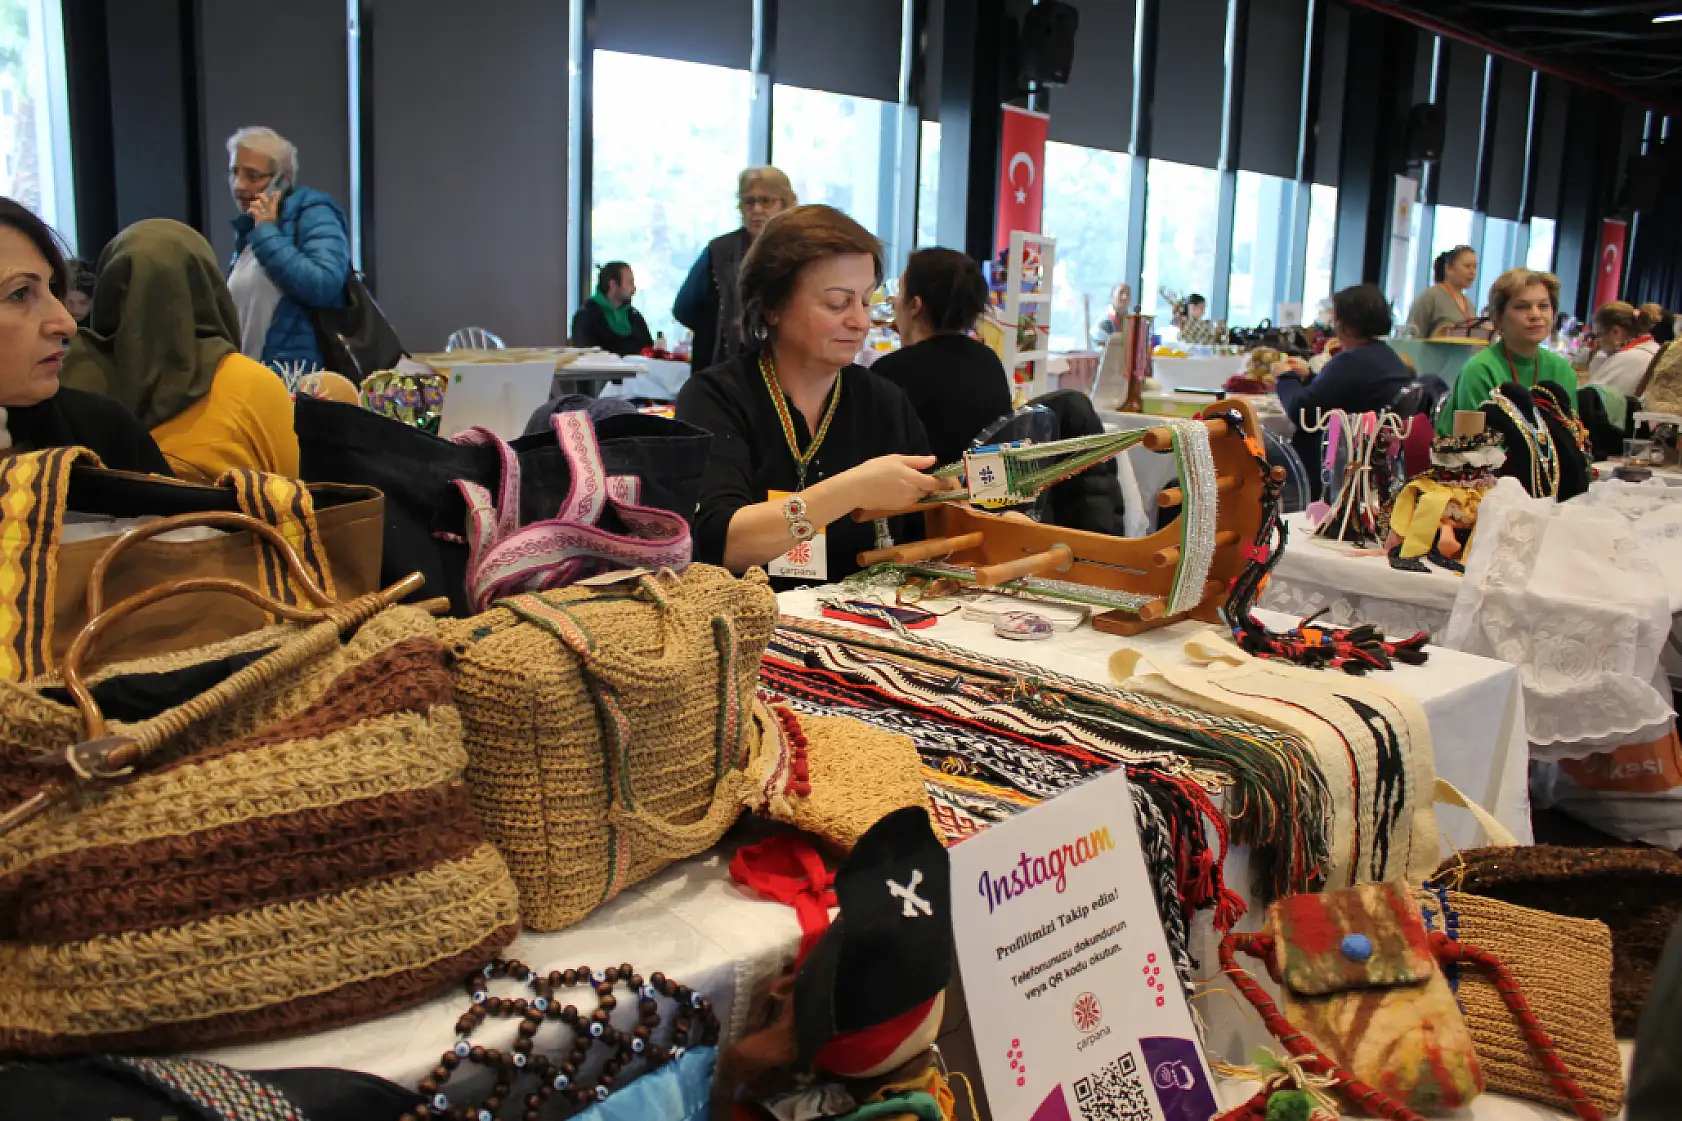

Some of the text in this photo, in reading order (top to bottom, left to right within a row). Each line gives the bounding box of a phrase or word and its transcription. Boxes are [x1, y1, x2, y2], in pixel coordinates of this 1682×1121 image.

[978, 826, 1115, 914] Instagram
[995, 887, 1119, 961] Profilimizi Takip edin!
[1010, 920, 1127, 987] Telefonunuzu dokundurun
[1025, 943, 1122, 1000] veya QR kodu okutun.
[1077, 1025, 1111, 1052] çarpana
